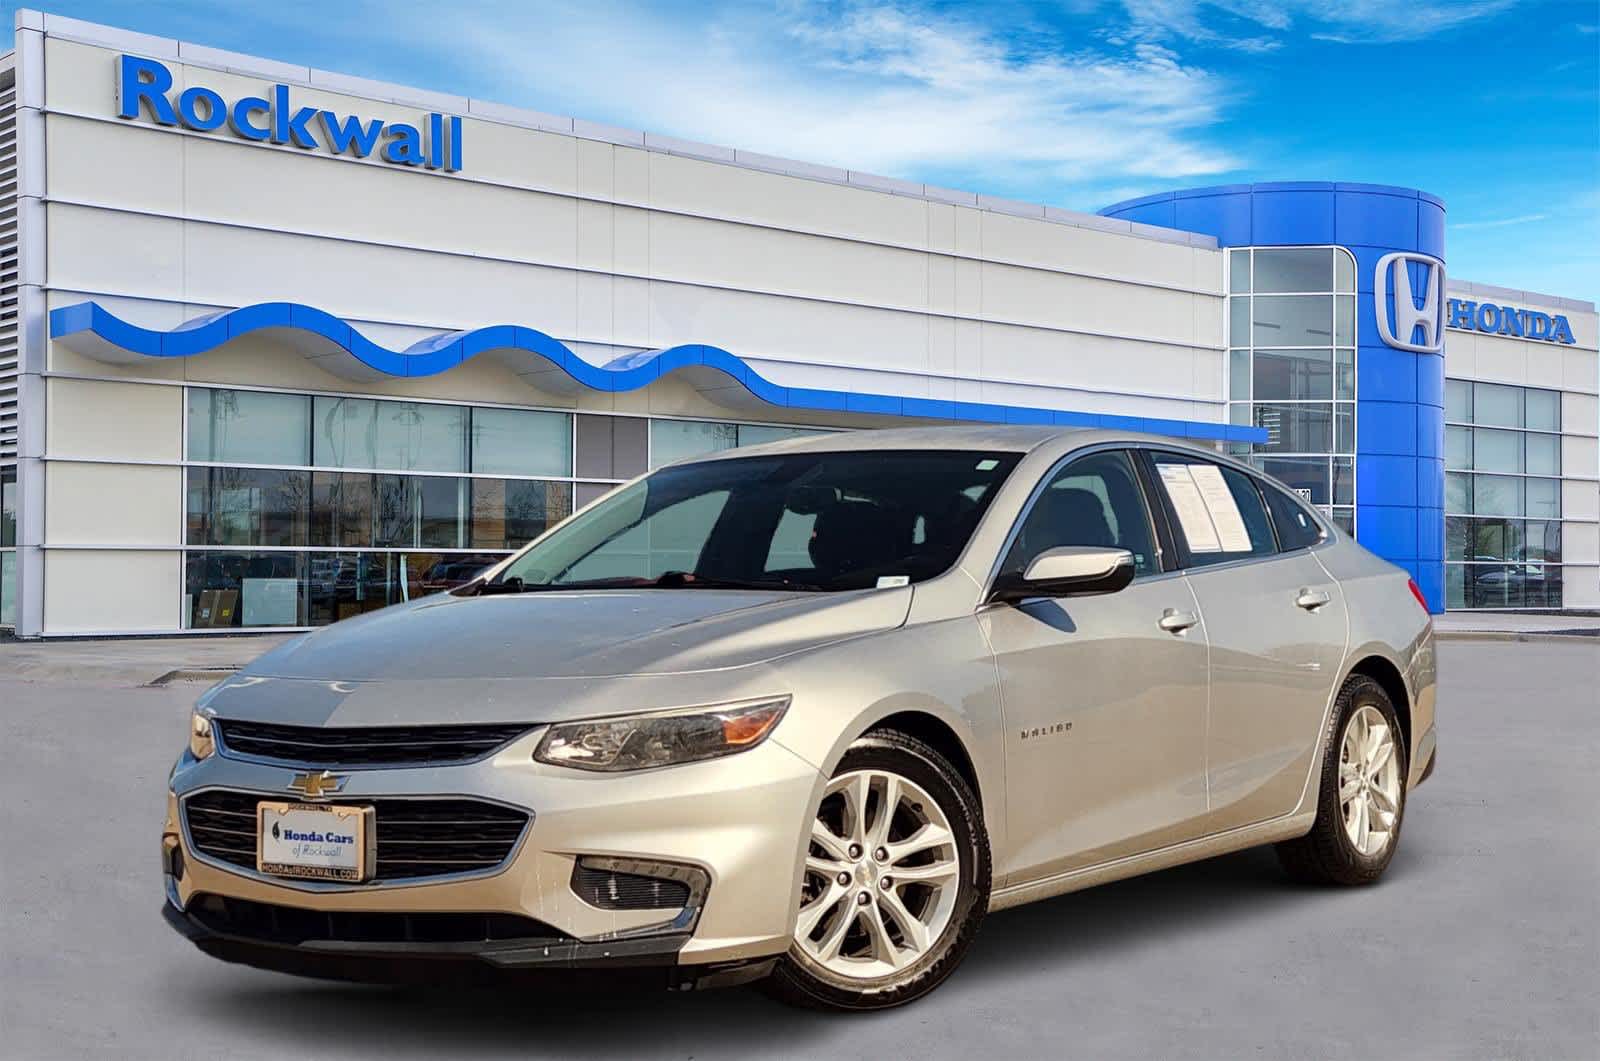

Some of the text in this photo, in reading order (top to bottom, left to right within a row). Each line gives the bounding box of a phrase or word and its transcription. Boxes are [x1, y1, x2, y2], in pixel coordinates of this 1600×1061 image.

[117, 54, 463, 172] Rockwall
[1447, 298, 1577, 344] HONDA
[284, 830, 354, 844] Honda Cars
